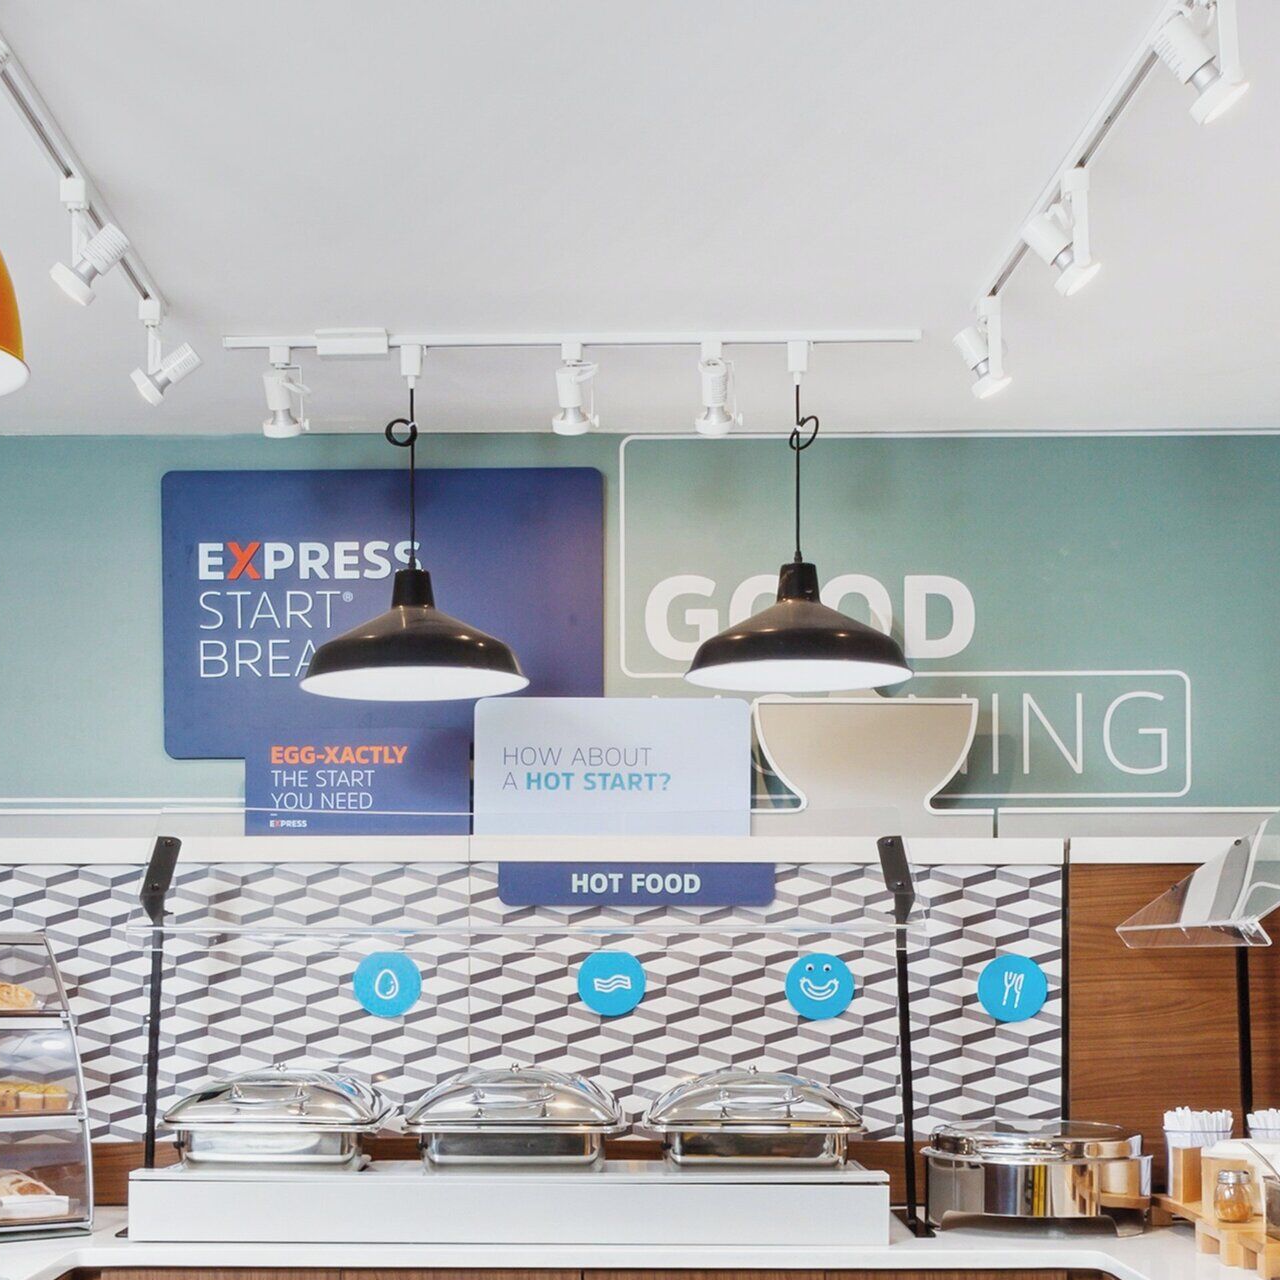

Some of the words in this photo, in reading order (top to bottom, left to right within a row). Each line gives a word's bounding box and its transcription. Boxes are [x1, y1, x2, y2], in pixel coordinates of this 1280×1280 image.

[270, 745, 409, 766] EGG-XACTLY
[503, 747, 561, 767] HOW
[571, 746, 652, 767] ABOUT
[270, 770, 309, 788] THE
[315, 770, 376, 788] START
[502, 772, 518, 791] A
[526, 772, 575, 792] HOT
[583, 772, 672, 792] START?
[271, 792, 315, 811] YOU
[321, 792, 374, 811] NEED
[269, 819, 307, 829] EXPRESS
[571, 873, 623, 894] HOT
[630, 873, 701, 895] FOOD
